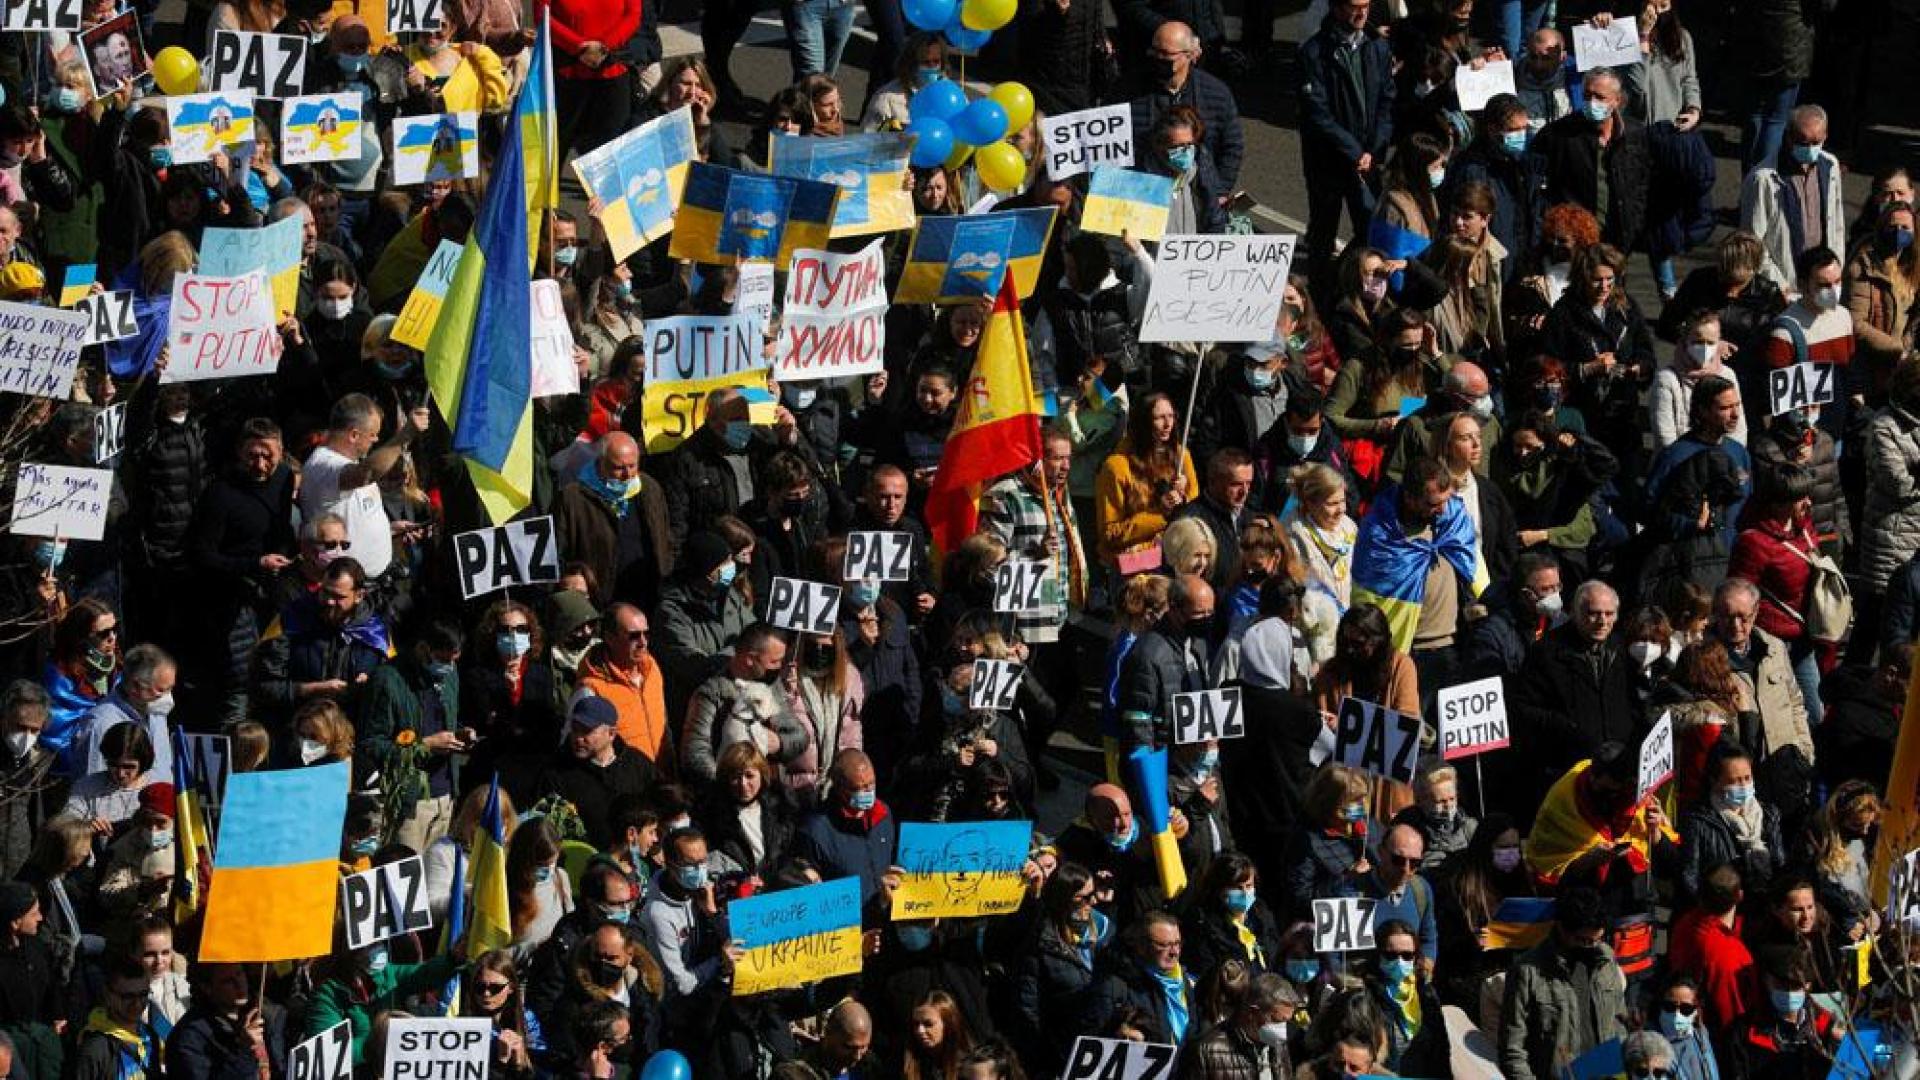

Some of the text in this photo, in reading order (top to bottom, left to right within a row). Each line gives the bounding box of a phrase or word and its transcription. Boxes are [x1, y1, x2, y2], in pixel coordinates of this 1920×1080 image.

[4, 0, 79, 28] PAZ
[387, 0, 441, 32] PAZ
[212, 32, 304, 97] PAZ
[1054, 116, 1124, 144] STOP
[1054, 141, 1129, 170] PUTIN
[1164, 240, 1290, 265] STOP WAR
[180, 273, 259, 322] STOP
[196, 326, 284, 370] PUTIN
[1772, 364, 1832, 414] PAZ
[97, 405, 124, 461] PAZ
[663, 392, 706, 438] ST
[457, 519, 557, 596] PAZ
[847, 534, 911, 579] PAZ
[769, 578, 840, 632] PAZ
[996, 563, 1048, 610] PAZ
[972, 660, 1025, 707] PAZ
[1445, 691, 1498, 720] STOP
[1176, 690, 1242, 741] PAZ
[1445, 720, 1506, 752] PUTIN
[1336, 697, 1421, 784] PAZ
[345, 859, 430, 946] PAZ
[1315, 900, 1376, 950] PAZ
[294, 1025, 350, 1080] PAZ
[399, 1031, 482, 1051] STOP
[1067, 1039, 1174, 1080] PAZ
[393, 1060, 484, 1080] PUTIN
